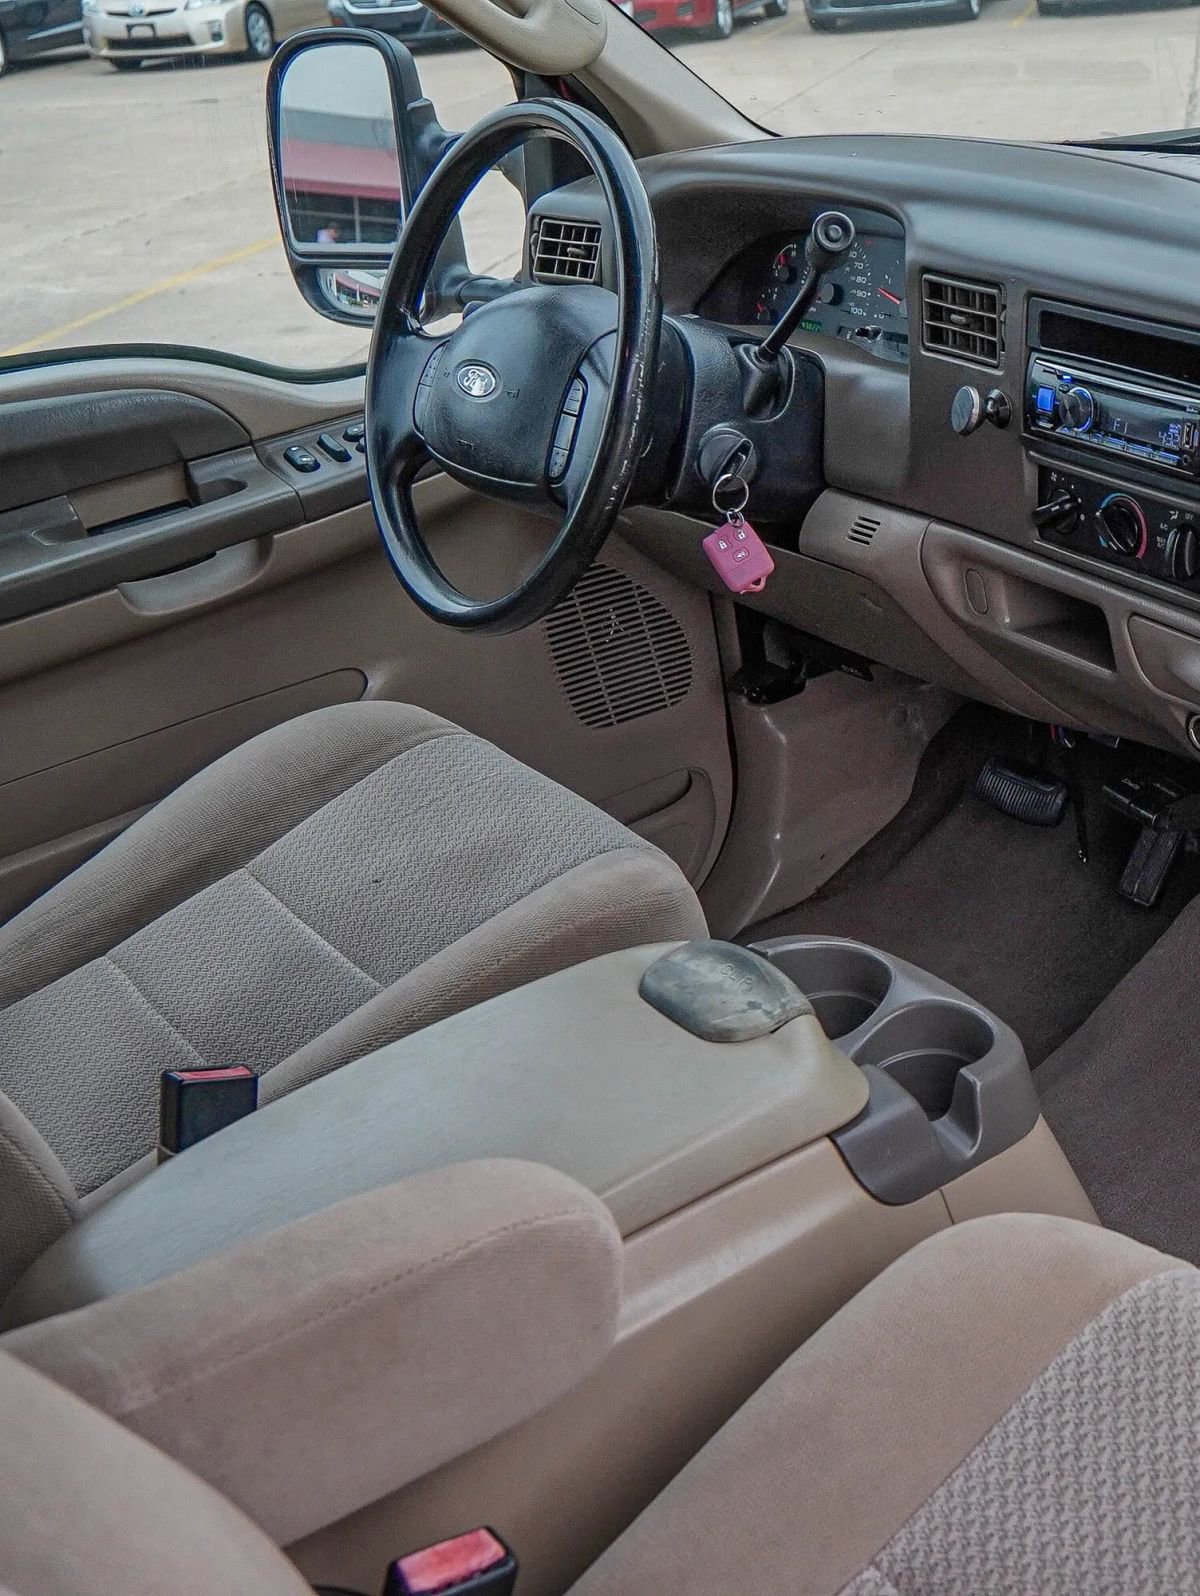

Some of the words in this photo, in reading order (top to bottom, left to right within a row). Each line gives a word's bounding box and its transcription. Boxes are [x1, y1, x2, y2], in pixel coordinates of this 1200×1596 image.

[854, 262, 864, 270] 70
[856, 276, 867, 284] 80
[856, 289, 867, 298] 90
[850, 307, 863, 315] 100
